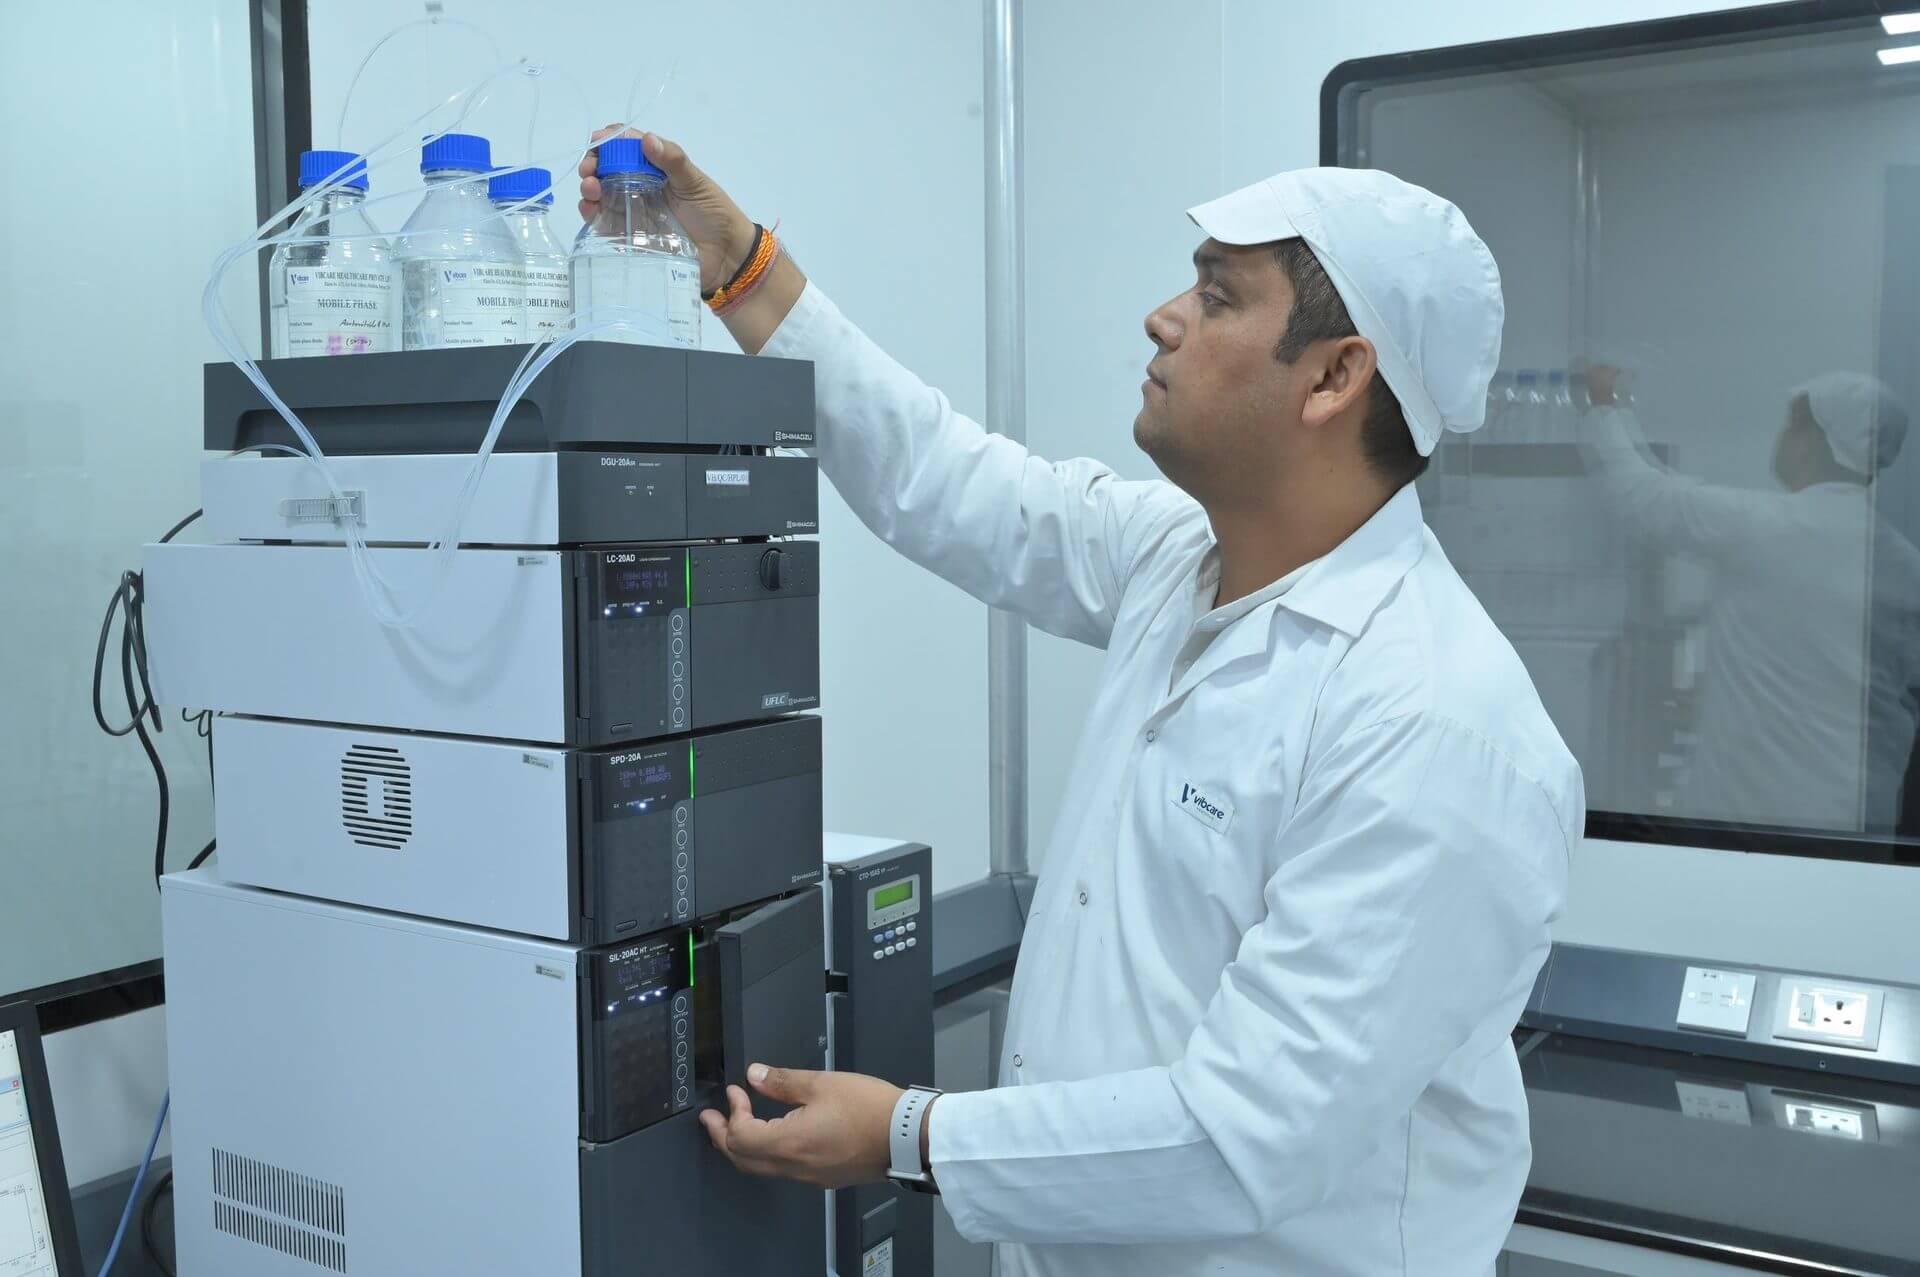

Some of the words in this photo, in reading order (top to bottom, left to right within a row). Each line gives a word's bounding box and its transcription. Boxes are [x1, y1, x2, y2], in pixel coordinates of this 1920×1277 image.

[315, 271, 336, 280] VIBCARE
[336, 271, 368, 281] HEALTHCARE
[317, 298, 352, 309] MOBILE
[352, 299, 377, 310] PHASE
[476, 296, 507, 306] MOBILE
[606, 554, 636, 564] LC-20AD
[765, 695, 786, 706] UFLC
[610, 752, 642, 765] SPD-20A
[608, 947, 639, 963] SIL-20AC
